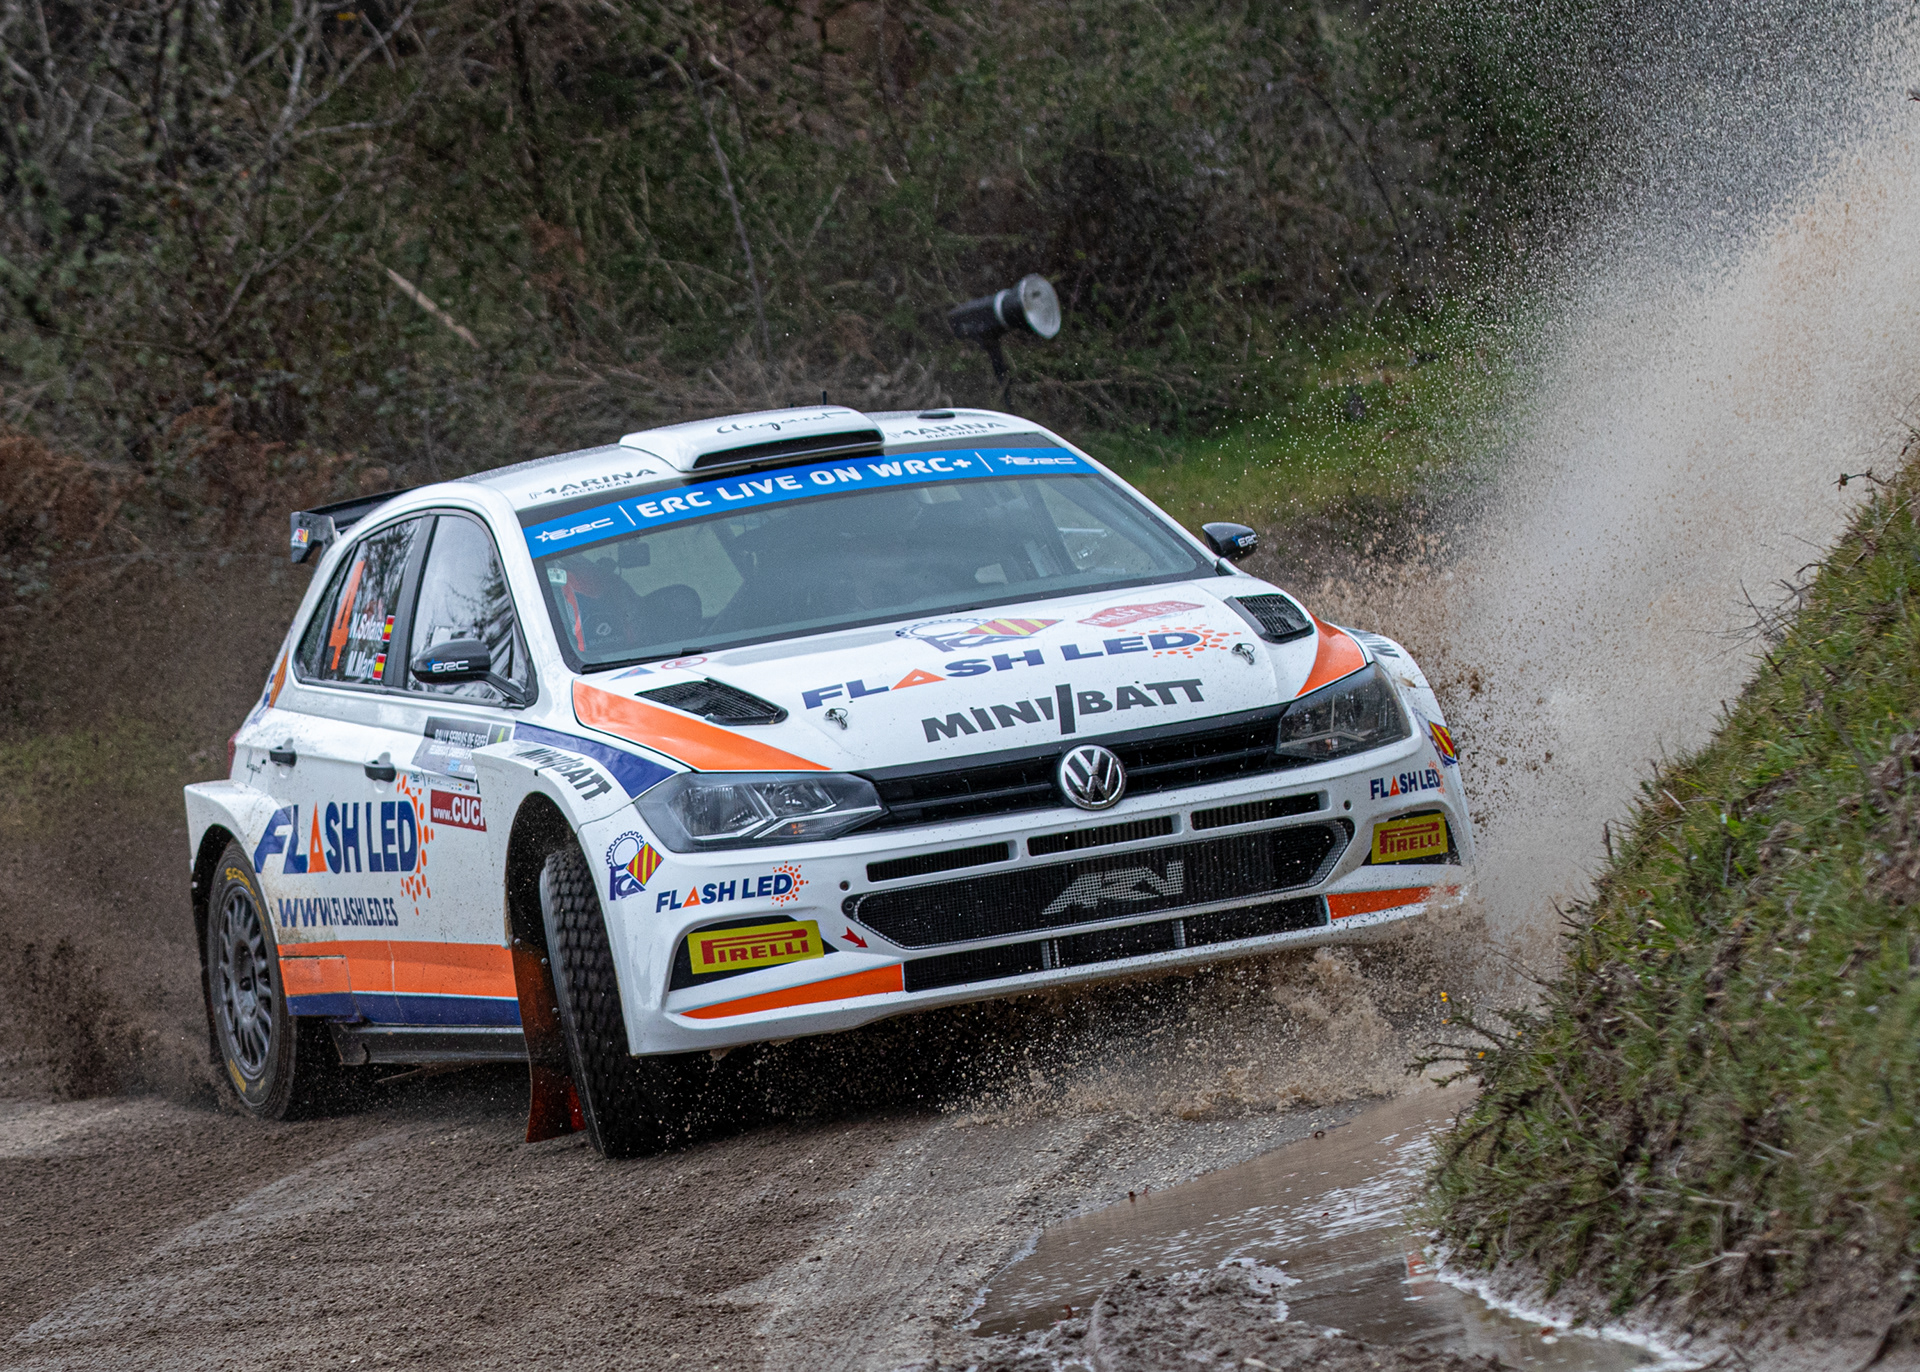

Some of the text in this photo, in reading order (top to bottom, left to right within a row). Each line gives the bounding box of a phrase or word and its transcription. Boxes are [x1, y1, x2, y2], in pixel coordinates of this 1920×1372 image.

[1008, 455, 1077, 466] ERC
[529, 468, 657, 500] MARINA
[636, 457, 973, 518] ERC LIVE ON WRC+
[547, 517, 614, 541] ERC
[328, 560, 366, 670] 4
[431, 659, 470, 673] ERC
[801, 631, 1201, 710] FLASH LED
[1370, 768, 1441, 801] FLASH LED
[253, 800, 418, 875] FLASH LED
[1379, 821, 1441, 855] PIRELLI
[609, 863, 647, 901] FCA
[655, 873, 793, 913] FLASH LED
[277, 897, 399, 927] WWW.FLASHLED.ES
[701, 928, 810, 965] PIRELLI
